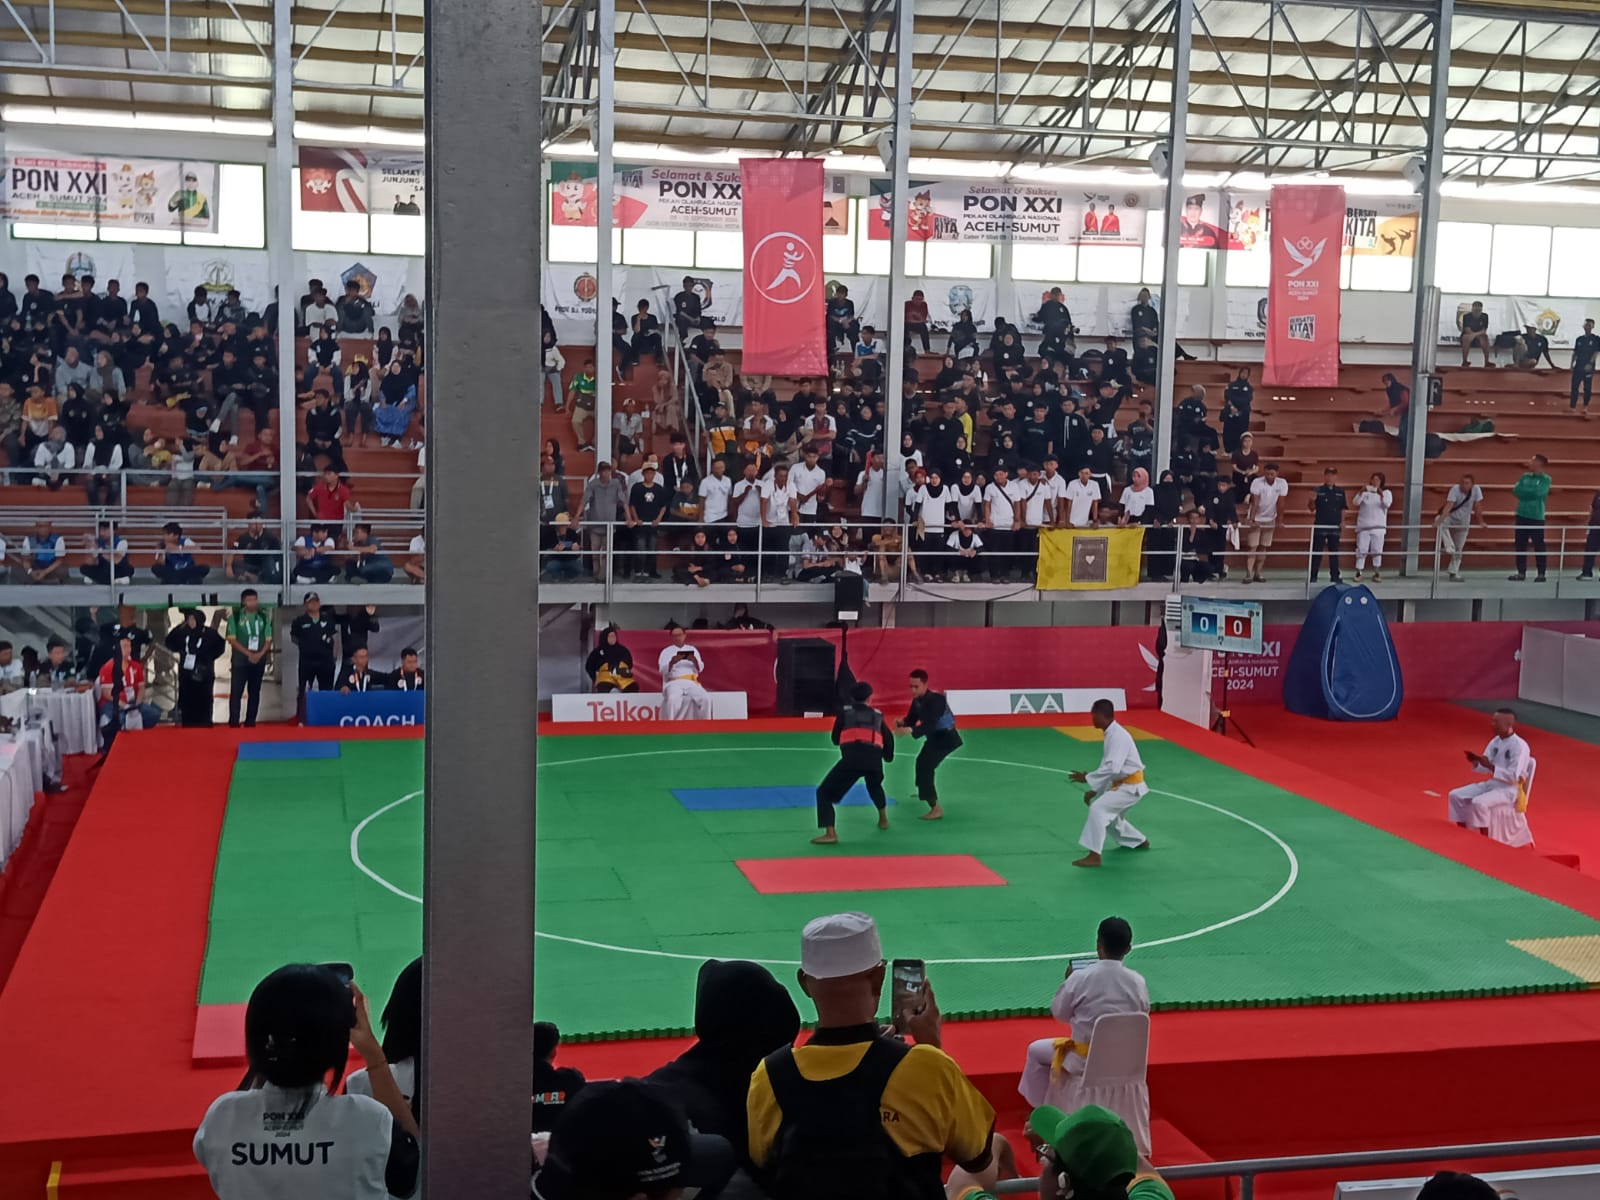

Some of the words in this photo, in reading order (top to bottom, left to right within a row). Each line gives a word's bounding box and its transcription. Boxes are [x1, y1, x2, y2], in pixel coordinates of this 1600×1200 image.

[382, 168, 420, 176] SELAMAT
[651, 169, 700, 181] Selamat
[704, 171, 713, 182] &
[715, 171, 741, 183] Suk
[12, 168, 59, 192] PON
[67, 171, 107, 195] XXI
[382, 176, 420, 184] JUNJUNG
[659, 181, 706, 198] PON
[712, 183, 742, 200] XX
[968, 185, 1010, 194] Selamat
[1025, 187, 1058, 196] Sukses
[12, 192, 40, 200] ACEH
[49, 194, 83, 203] SUMUT
[963, 195, 1017, 212] PON
[1023, 197, 1062, 213] XXI
[671, 205, 737, 216] ACEH-SUMUT
[964, 221, 1060, 233] ACEH-SUMUT
[1345, 218, 1376, 237] KITA
[1200, 617, 1209, 632] 0
[1233, 620, 1243, 635] 0
[1227, 680, 1254, 690] 2024
[340, 715, 416, 727] COACH
[232, 1141, 335, 1165] SUMUT
